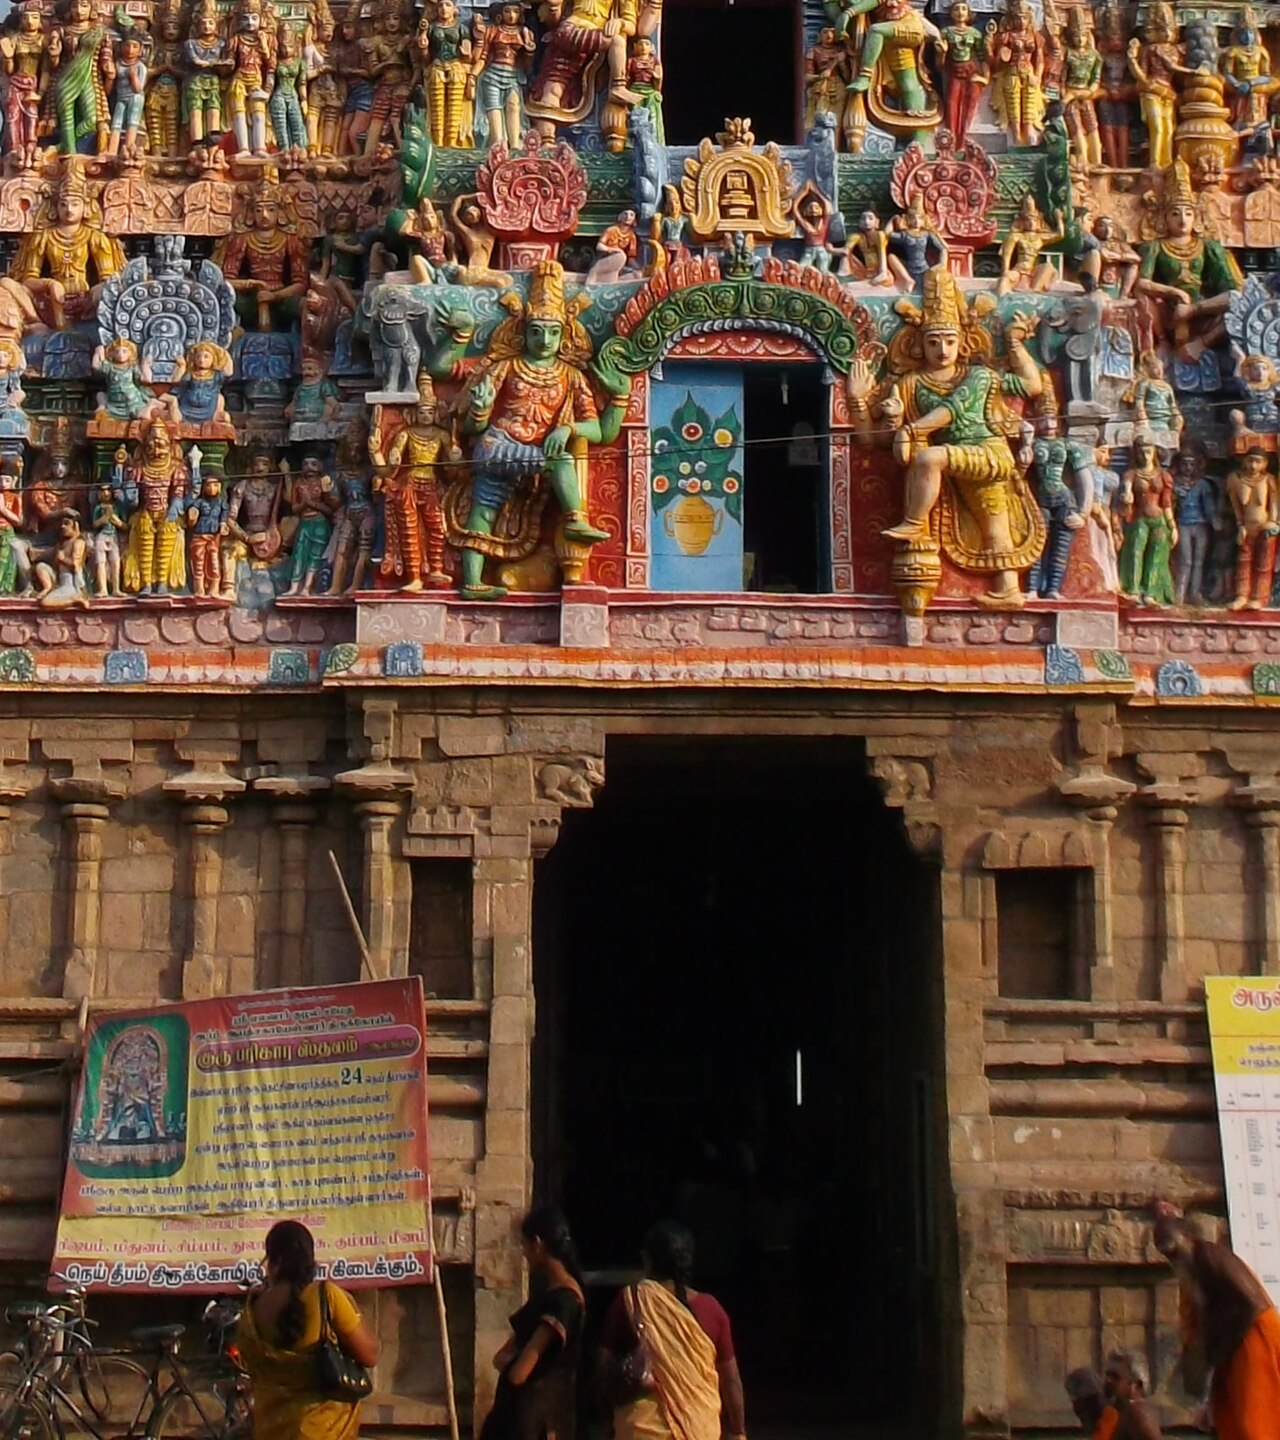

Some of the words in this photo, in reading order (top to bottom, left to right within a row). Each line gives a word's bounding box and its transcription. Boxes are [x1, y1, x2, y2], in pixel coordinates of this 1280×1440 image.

[200, 1050, 232, 1068] குரு
[236, 1042, 292, 1063] பரிகார
[298, 1035, 358, 1058] ஸ்தலம்
[341, 1067, 363, 1085] 24
[68, 1263, 107, 1284] நெய்
[110, 1262, 148, 1285] தீபம்
[332, 1254, 423, 1278] கிடைக்கும்.
